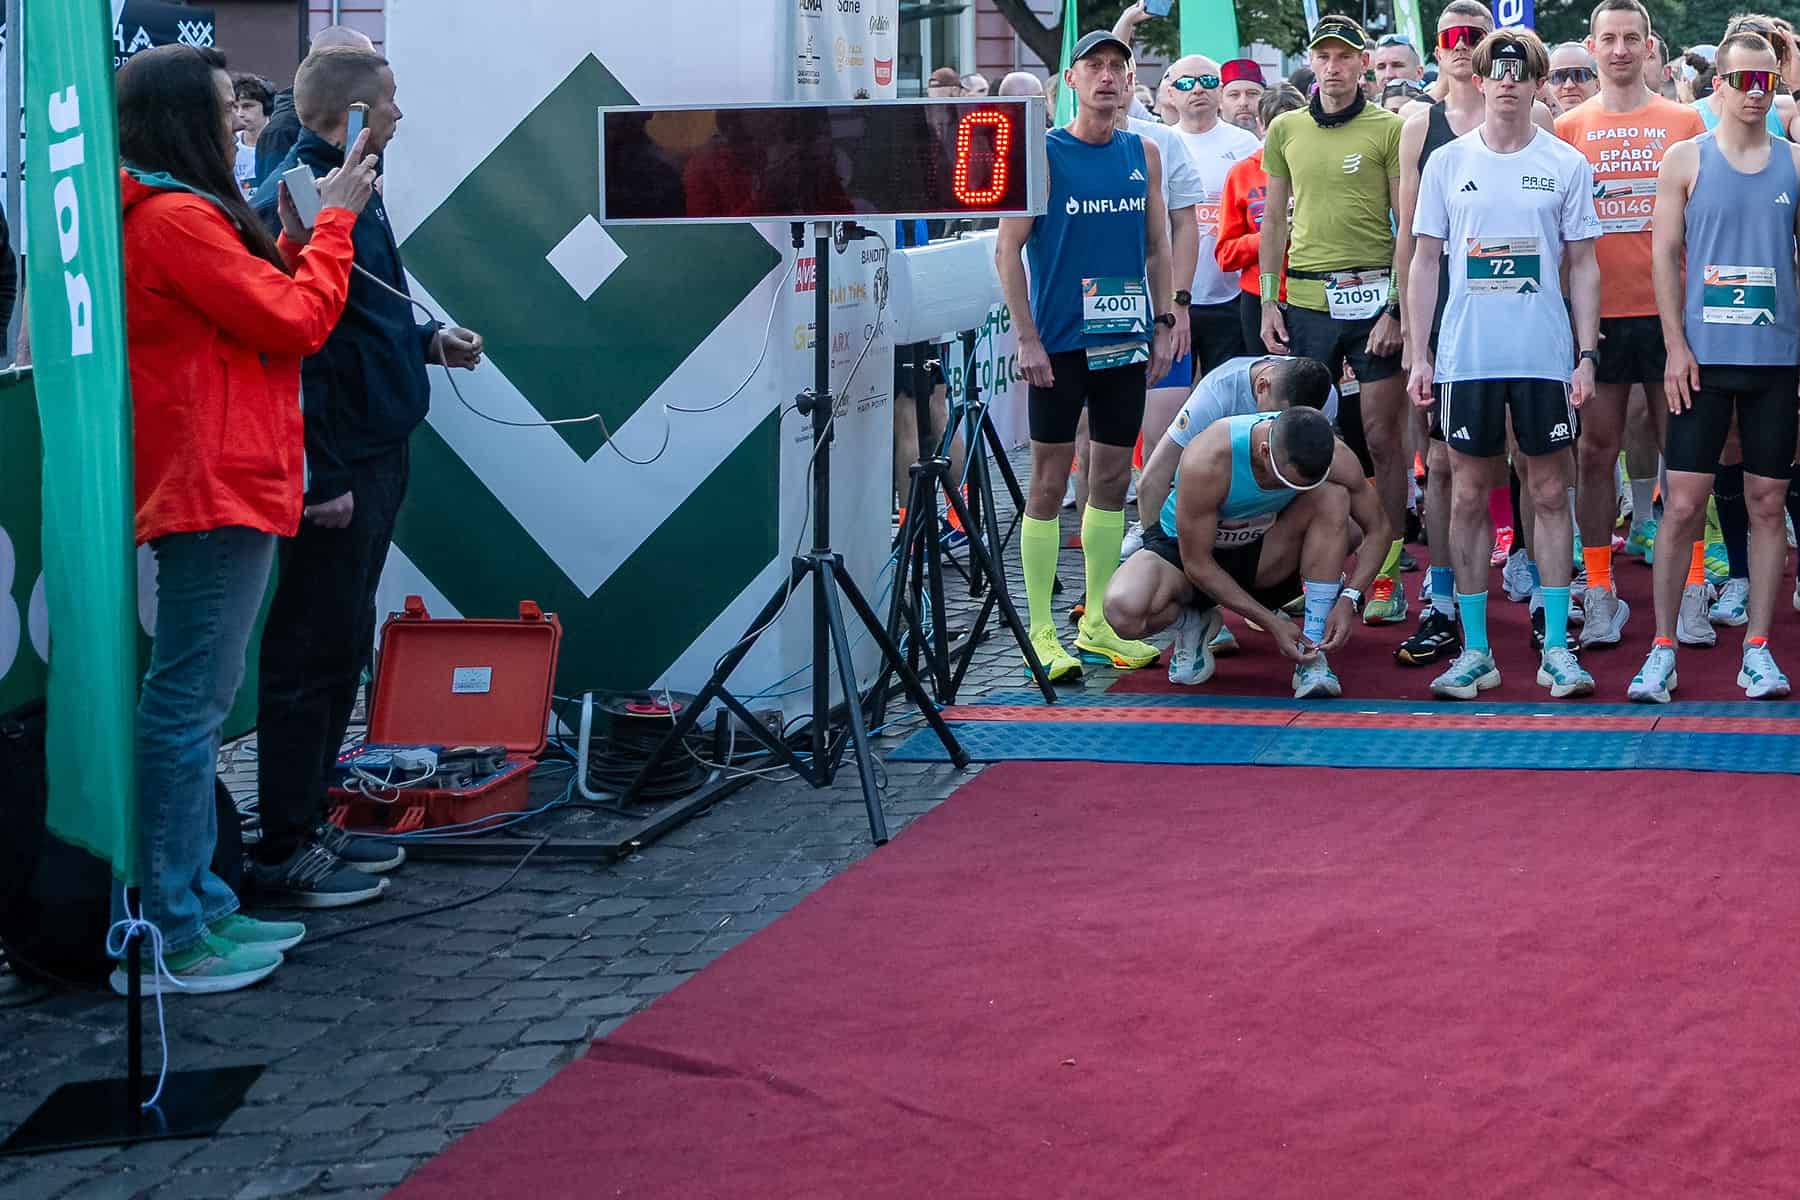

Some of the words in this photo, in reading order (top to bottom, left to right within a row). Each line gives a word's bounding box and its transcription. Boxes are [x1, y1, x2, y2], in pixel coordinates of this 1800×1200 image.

[1586, 128, 1639, 141] БРАВО
[1643, 127, 1667, 139] МК
[954, 111, 1009, 204] 0
[1600, 148, 1653, 161] БРАВО
[1599, 199, 1652, 216] 10146
[1490, 259, 1515, 275] 72
[1094, 296, 1138, 312] 4001
[1333, 289, 1381, 305] 21091
[1733, 288, 1745, 305] 2
